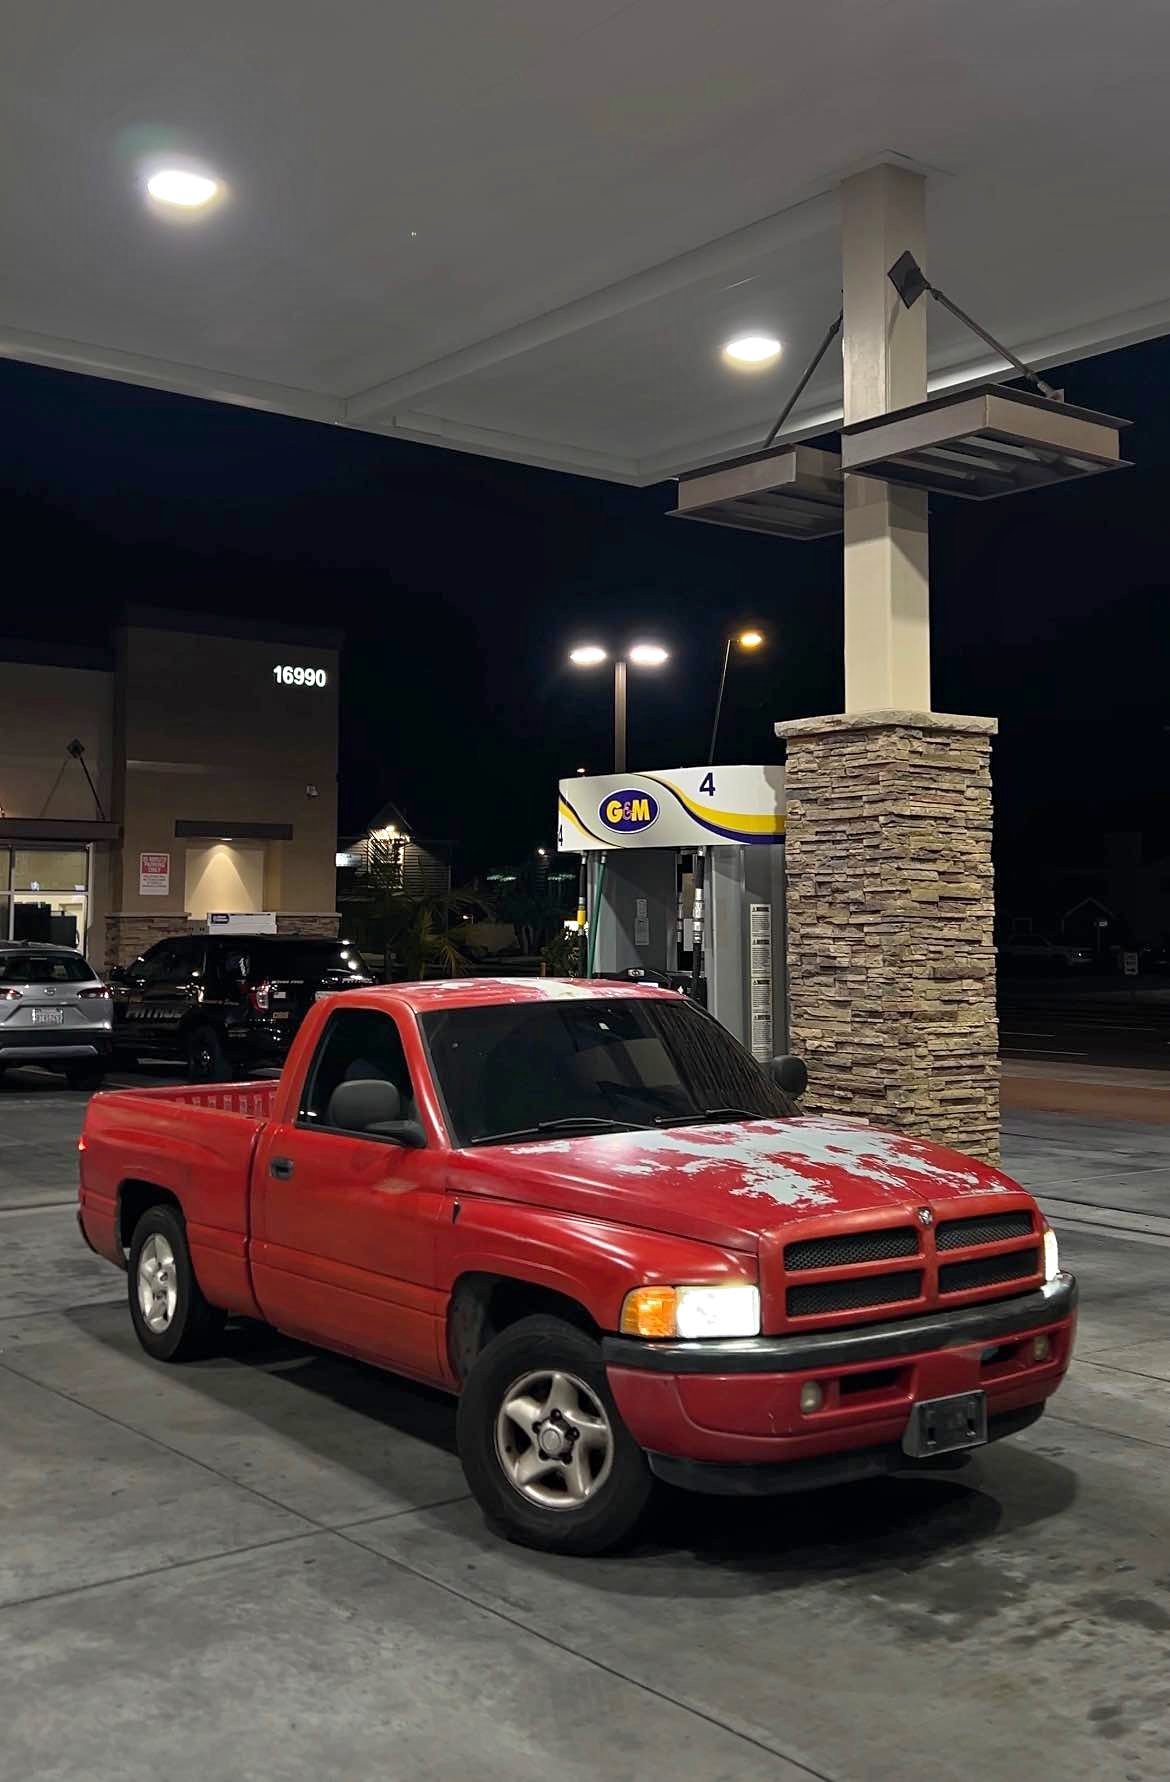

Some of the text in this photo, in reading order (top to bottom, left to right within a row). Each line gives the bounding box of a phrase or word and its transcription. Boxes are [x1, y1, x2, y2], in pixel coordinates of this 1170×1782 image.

[273, 665, 327, 688] 16990
[699, 772, 716, 797] 4
[606, 799, 651, 823] G&M
[557, 824, 564, 847] 4
